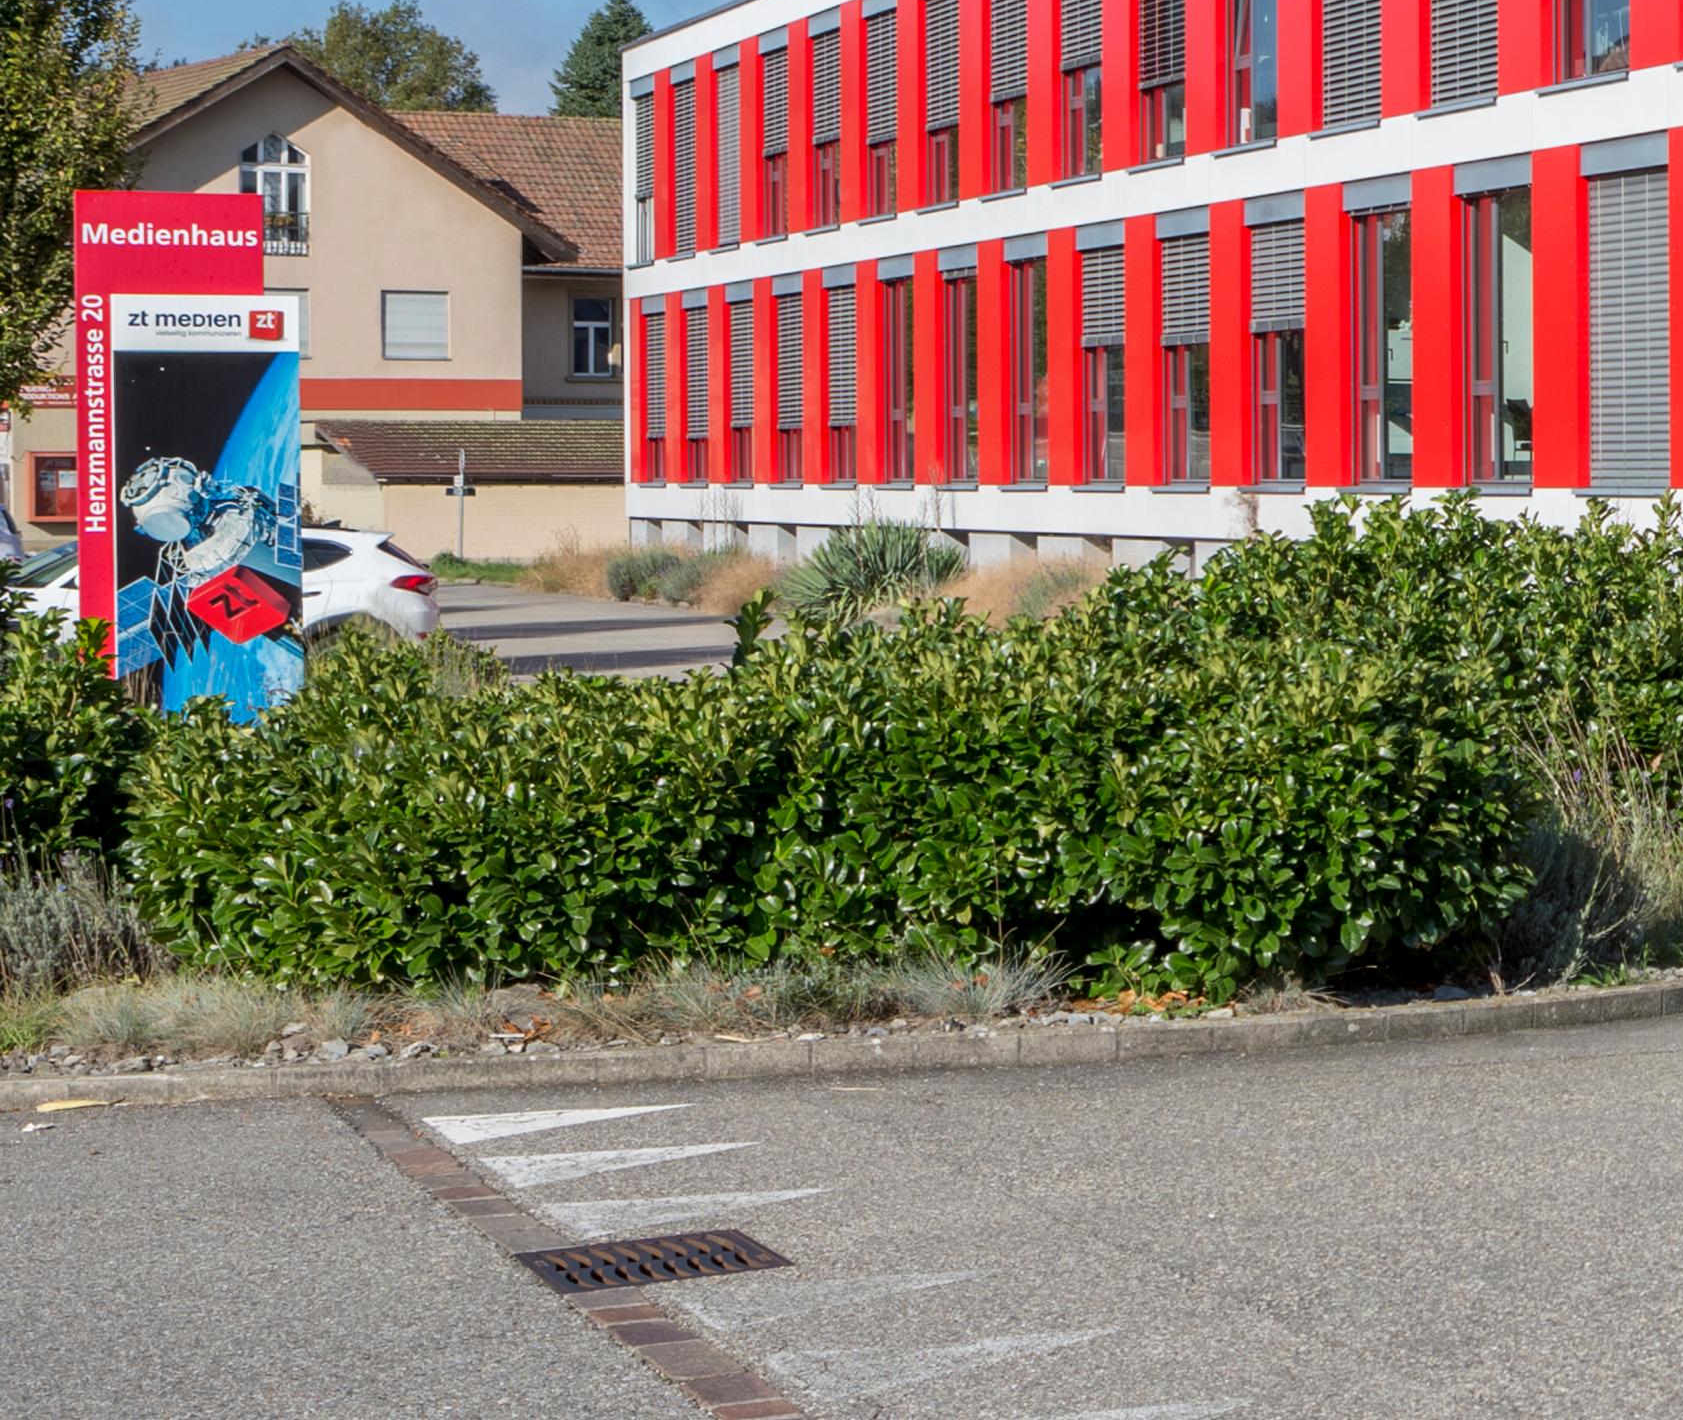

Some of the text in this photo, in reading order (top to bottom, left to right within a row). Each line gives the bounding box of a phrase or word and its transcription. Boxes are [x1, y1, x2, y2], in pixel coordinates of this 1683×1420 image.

[81, 222, 258, 247] Medienhaus
[128, 311, 148, 327] zt
[255, 312, 275, 329] zt
[81, 295, 106, 532] Henzmannstrasse 20
[208, 582, 259, 619] zt
